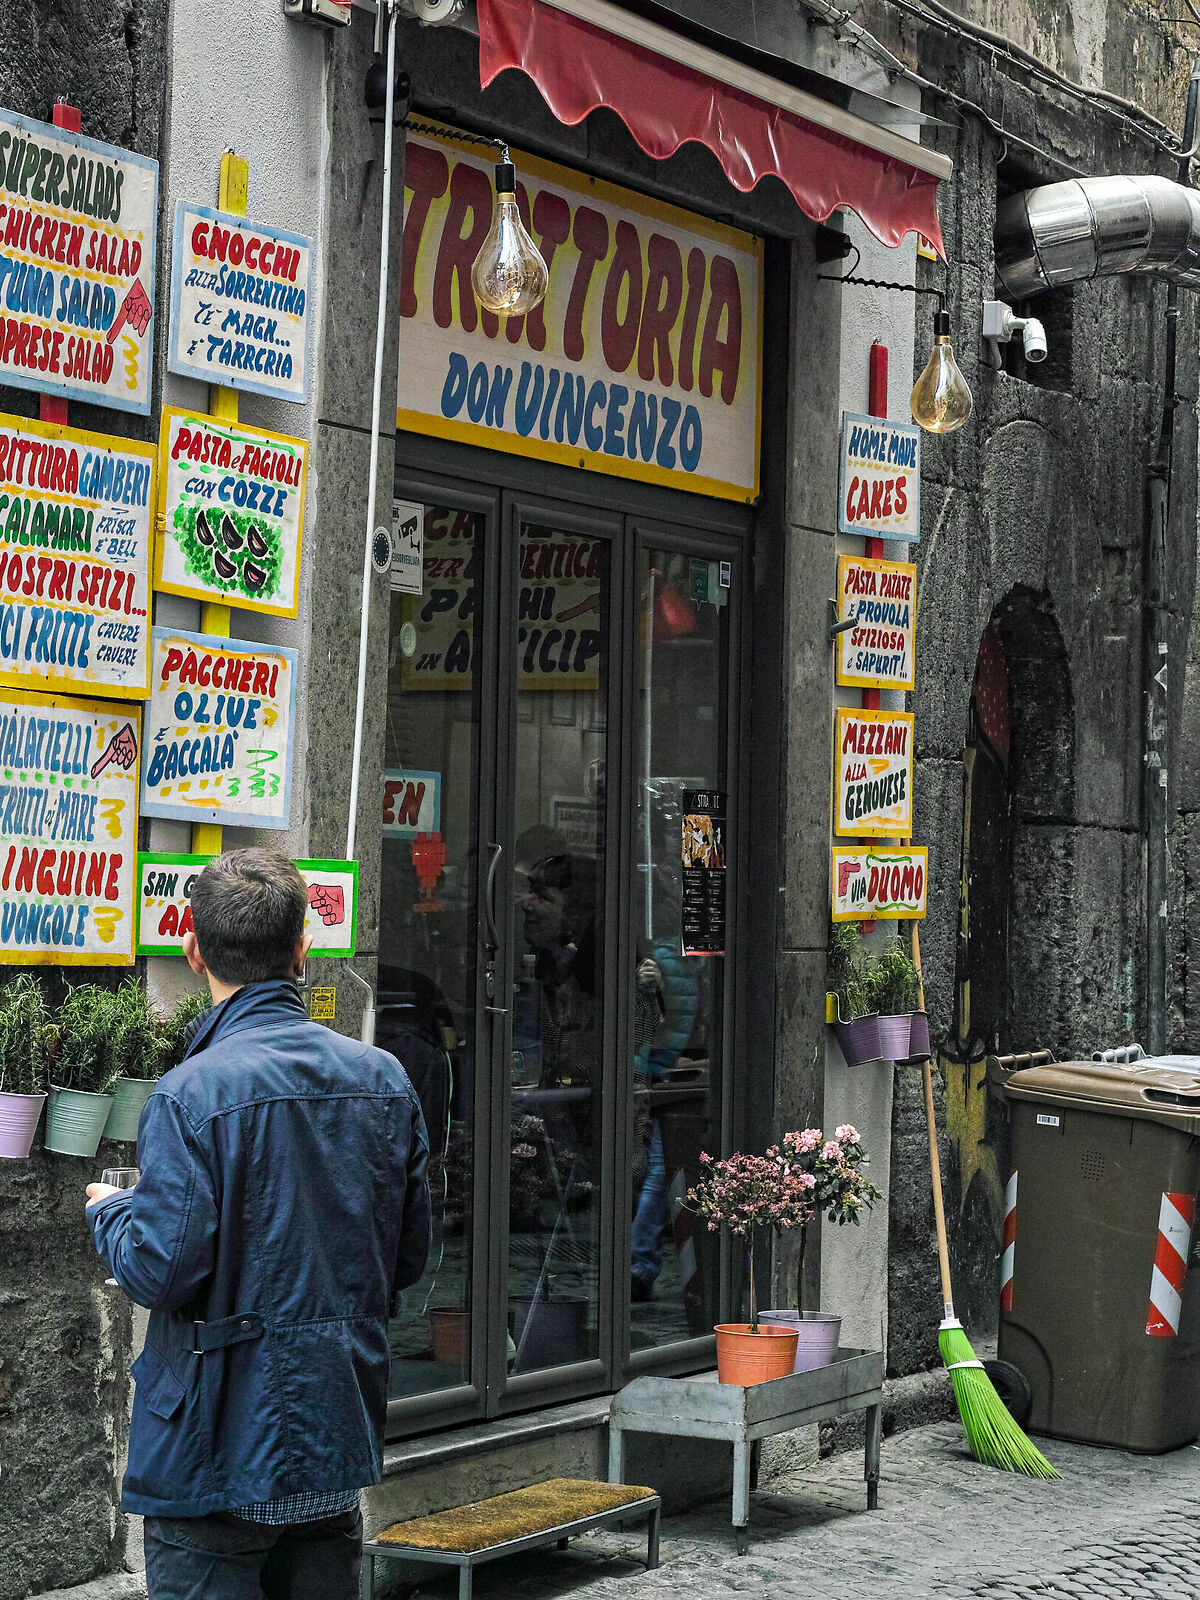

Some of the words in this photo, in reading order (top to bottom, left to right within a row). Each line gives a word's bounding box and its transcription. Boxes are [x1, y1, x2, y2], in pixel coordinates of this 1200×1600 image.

[85, 230, 142, 278] SALAD
[191, 221, 301, 282] GNOCCHI
[57, 275, 116, 332] SALAD
[184, 268, 218, 292] ALLA
[215, 264, 306, 317] SORRENTINA
[63, 335, 114, 385] SALAD
[441, 352, 514, 429] DON
[514, 361, 704, 473] VINCENZO
[171, 427, 232, 469] PASTA
[238, 444, 303, 487] FAGIOLI
[847, 425, 888, 462] HOME
[888, 432, 918, 469] MADE
[78, 452, 151, 507] GAMBERI
[184, 477, 218, 499] CON
[218, 475, 288, 517] COZZE
[846, 475, 908, 522] CAKES
[106, 538, 138, 559] BELL
[844, 567, 877, 598] PASTA
[879, 571, 913, 601] PATATE
[25, 605, 94, 668] FRITTE
[856, 599, 910, 630] PROVOLA
[851, 626, 905, 651] SFIZIOSA
[161, 648, 279, 698] PACCHERI
[174, 691, 262, 730] OLIVE
[843, 723, 907, 756] MEZZANI
[845, 762, 867, 782] ALLA
[845, 768, 906, 821] GENOVESE
[51, 790, 98, 842] MARE
[383, 780, 427, 827] EN
[143, 871, 178, 898] SAN
[851, 876, 867, 903] VIA
[867, 865, 923, 902] DUOMO
[1, 902, 89, 947] VONGOLE
